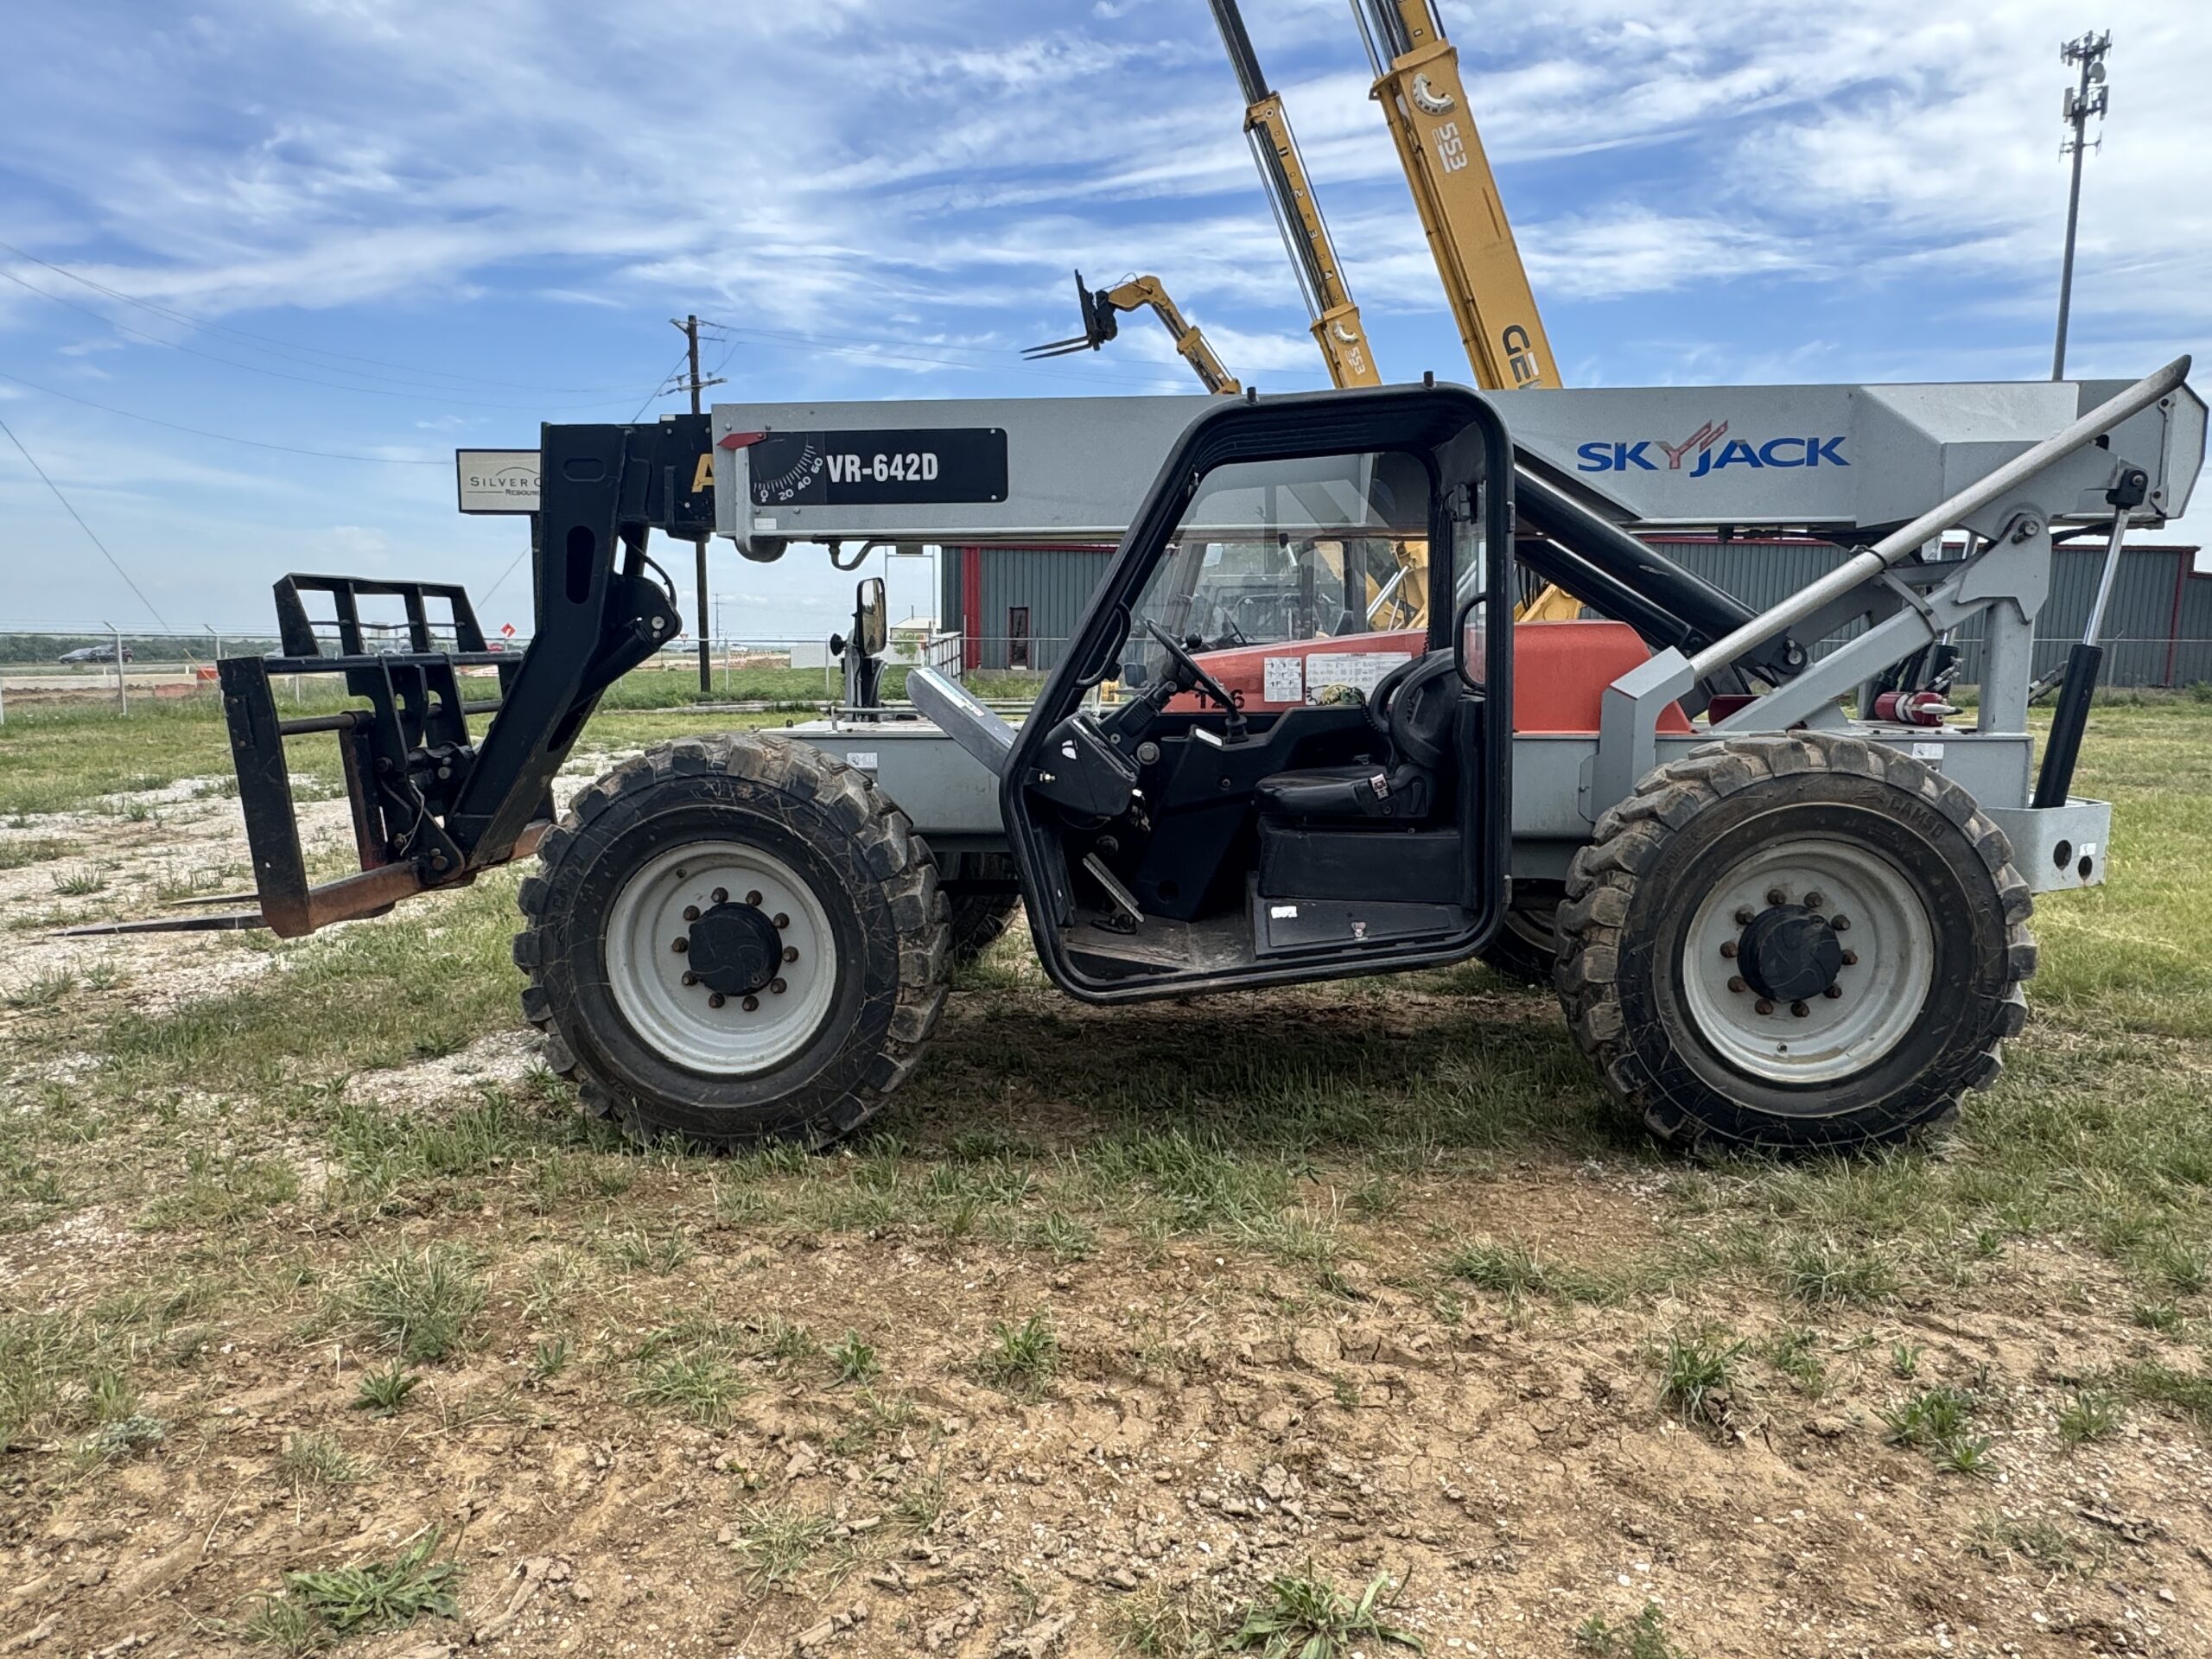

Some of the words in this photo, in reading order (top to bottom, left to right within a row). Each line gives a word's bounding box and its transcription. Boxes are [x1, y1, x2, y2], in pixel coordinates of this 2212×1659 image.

[1439, 122, 1468, 171] 553
[1349, 346, 1366, 375] 553
[826, 452, 938, 483] VR-642D
[1577, 419, 1851, 478] SKYJACK
[760, 489, 768, 499] 0
[779, 488, 794, 501] 20
[798, 476, 811, 491] 40
[810, 456, 823, 474] 60
[1887, 794, 1945, 841] CAMSO
